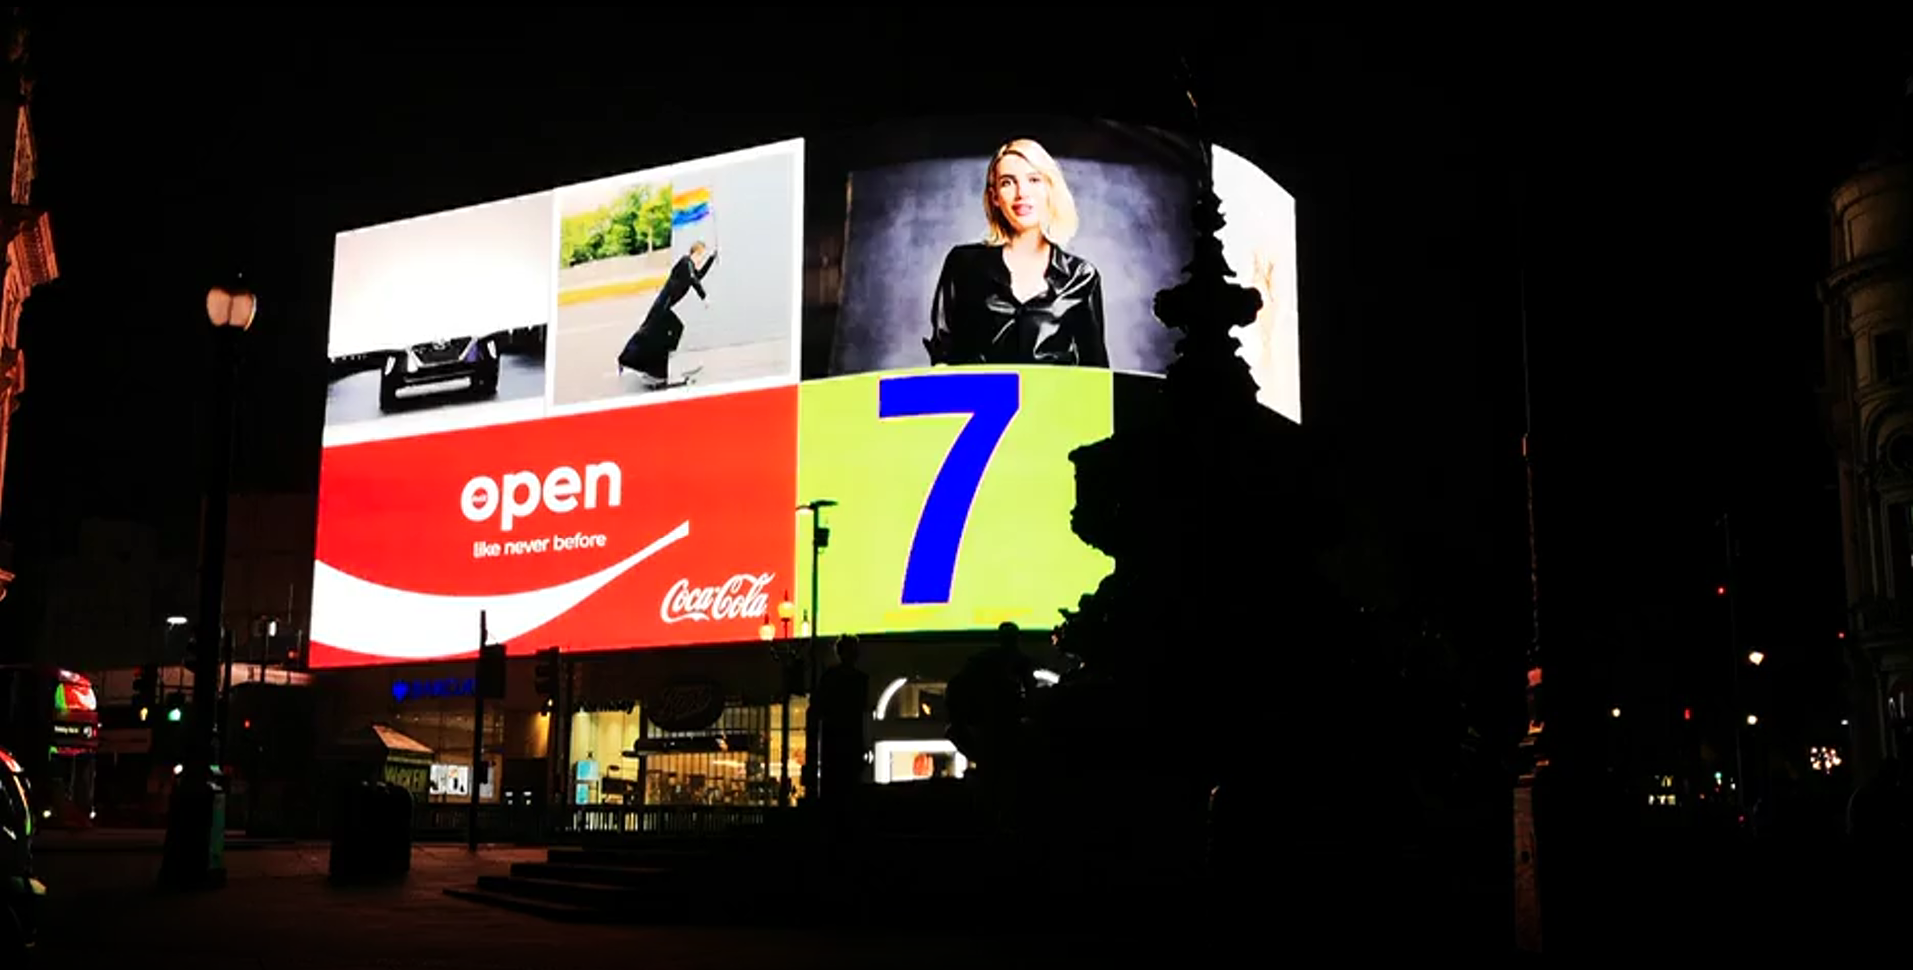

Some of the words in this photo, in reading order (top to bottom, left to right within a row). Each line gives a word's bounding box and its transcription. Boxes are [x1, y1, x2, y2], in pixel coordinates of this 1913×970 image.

[460, 460, 622, 532] open
[879, 374, 1020, 605] 7
[473, 541, 502, 558] like
[504, 537, 550, 555] never
[553, 532, 608, 551] before
[660, 572, 776, 624] Coca-Cola
